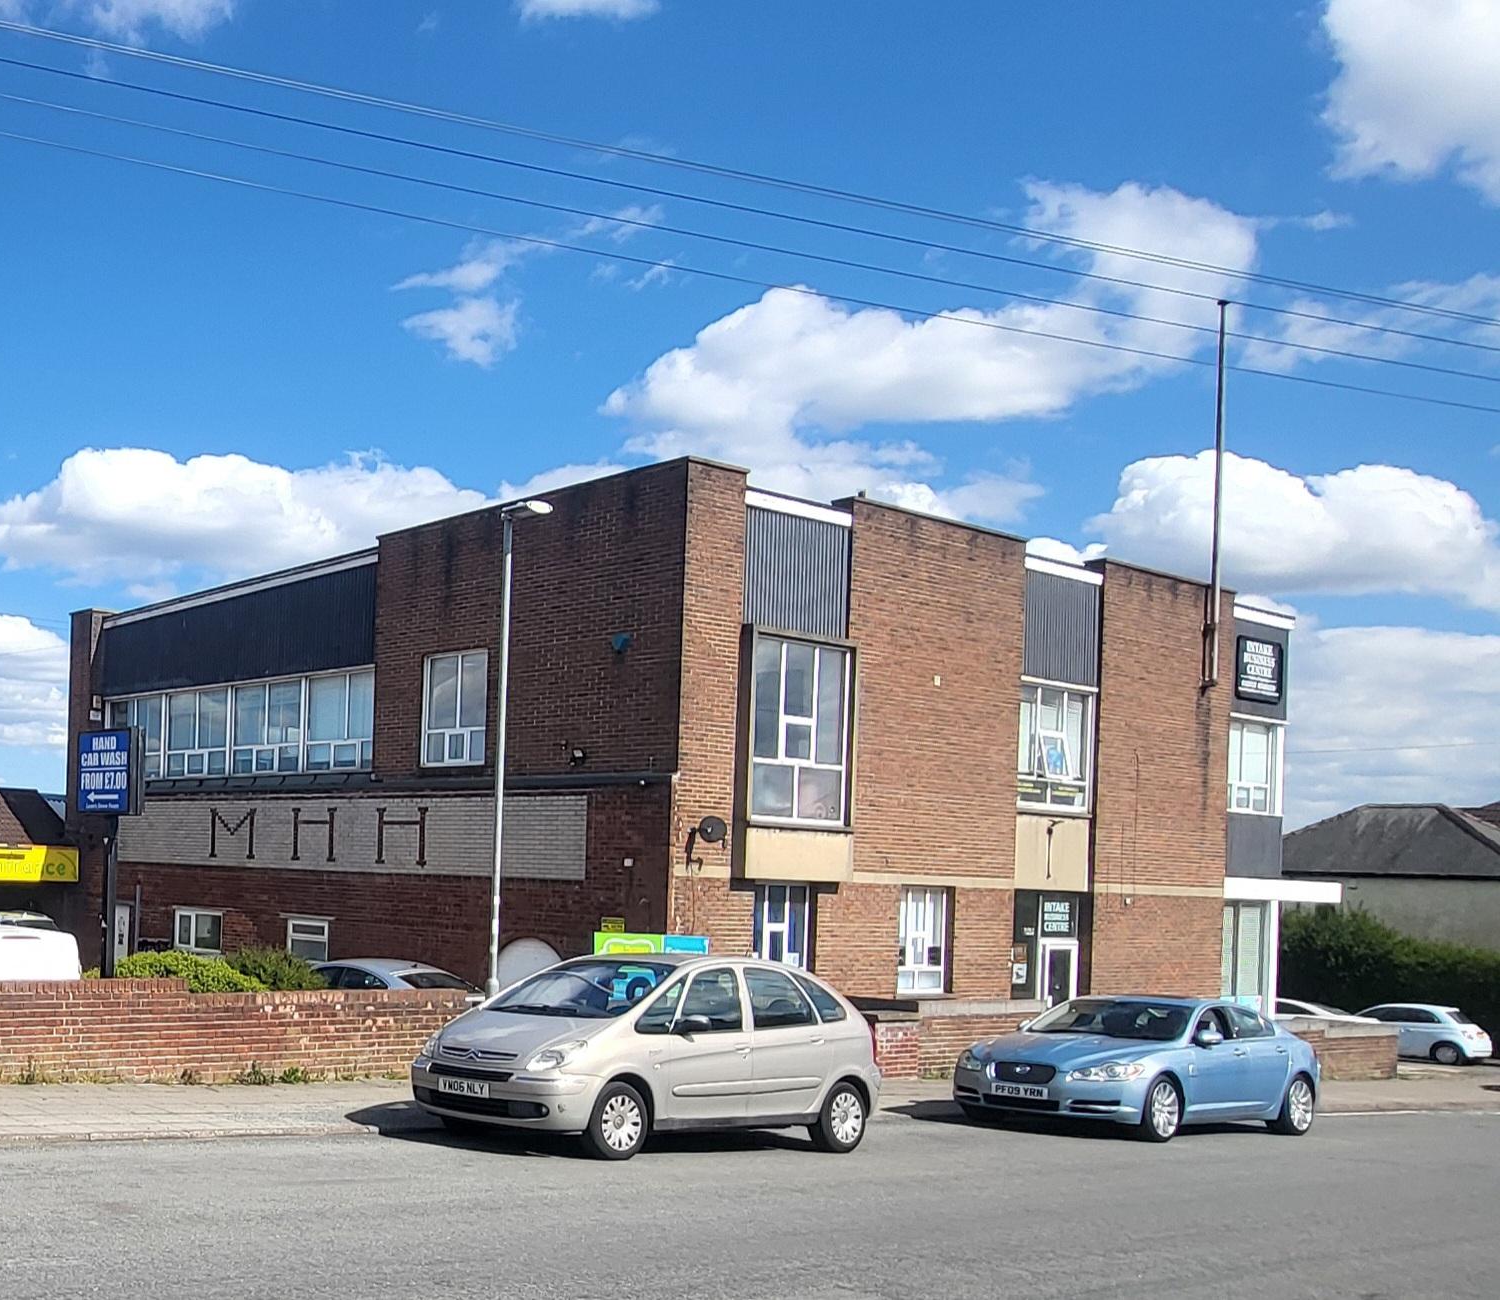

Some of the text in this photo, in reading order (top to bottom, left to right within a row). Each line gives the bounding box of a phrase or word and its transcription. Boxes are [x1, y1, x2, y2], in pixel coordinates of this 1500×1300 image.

[92, 736, 117, 751] HAND
[81, 751, 128, 767] CAR WASH
[81, 771, 127, 790] FROM £7.00
